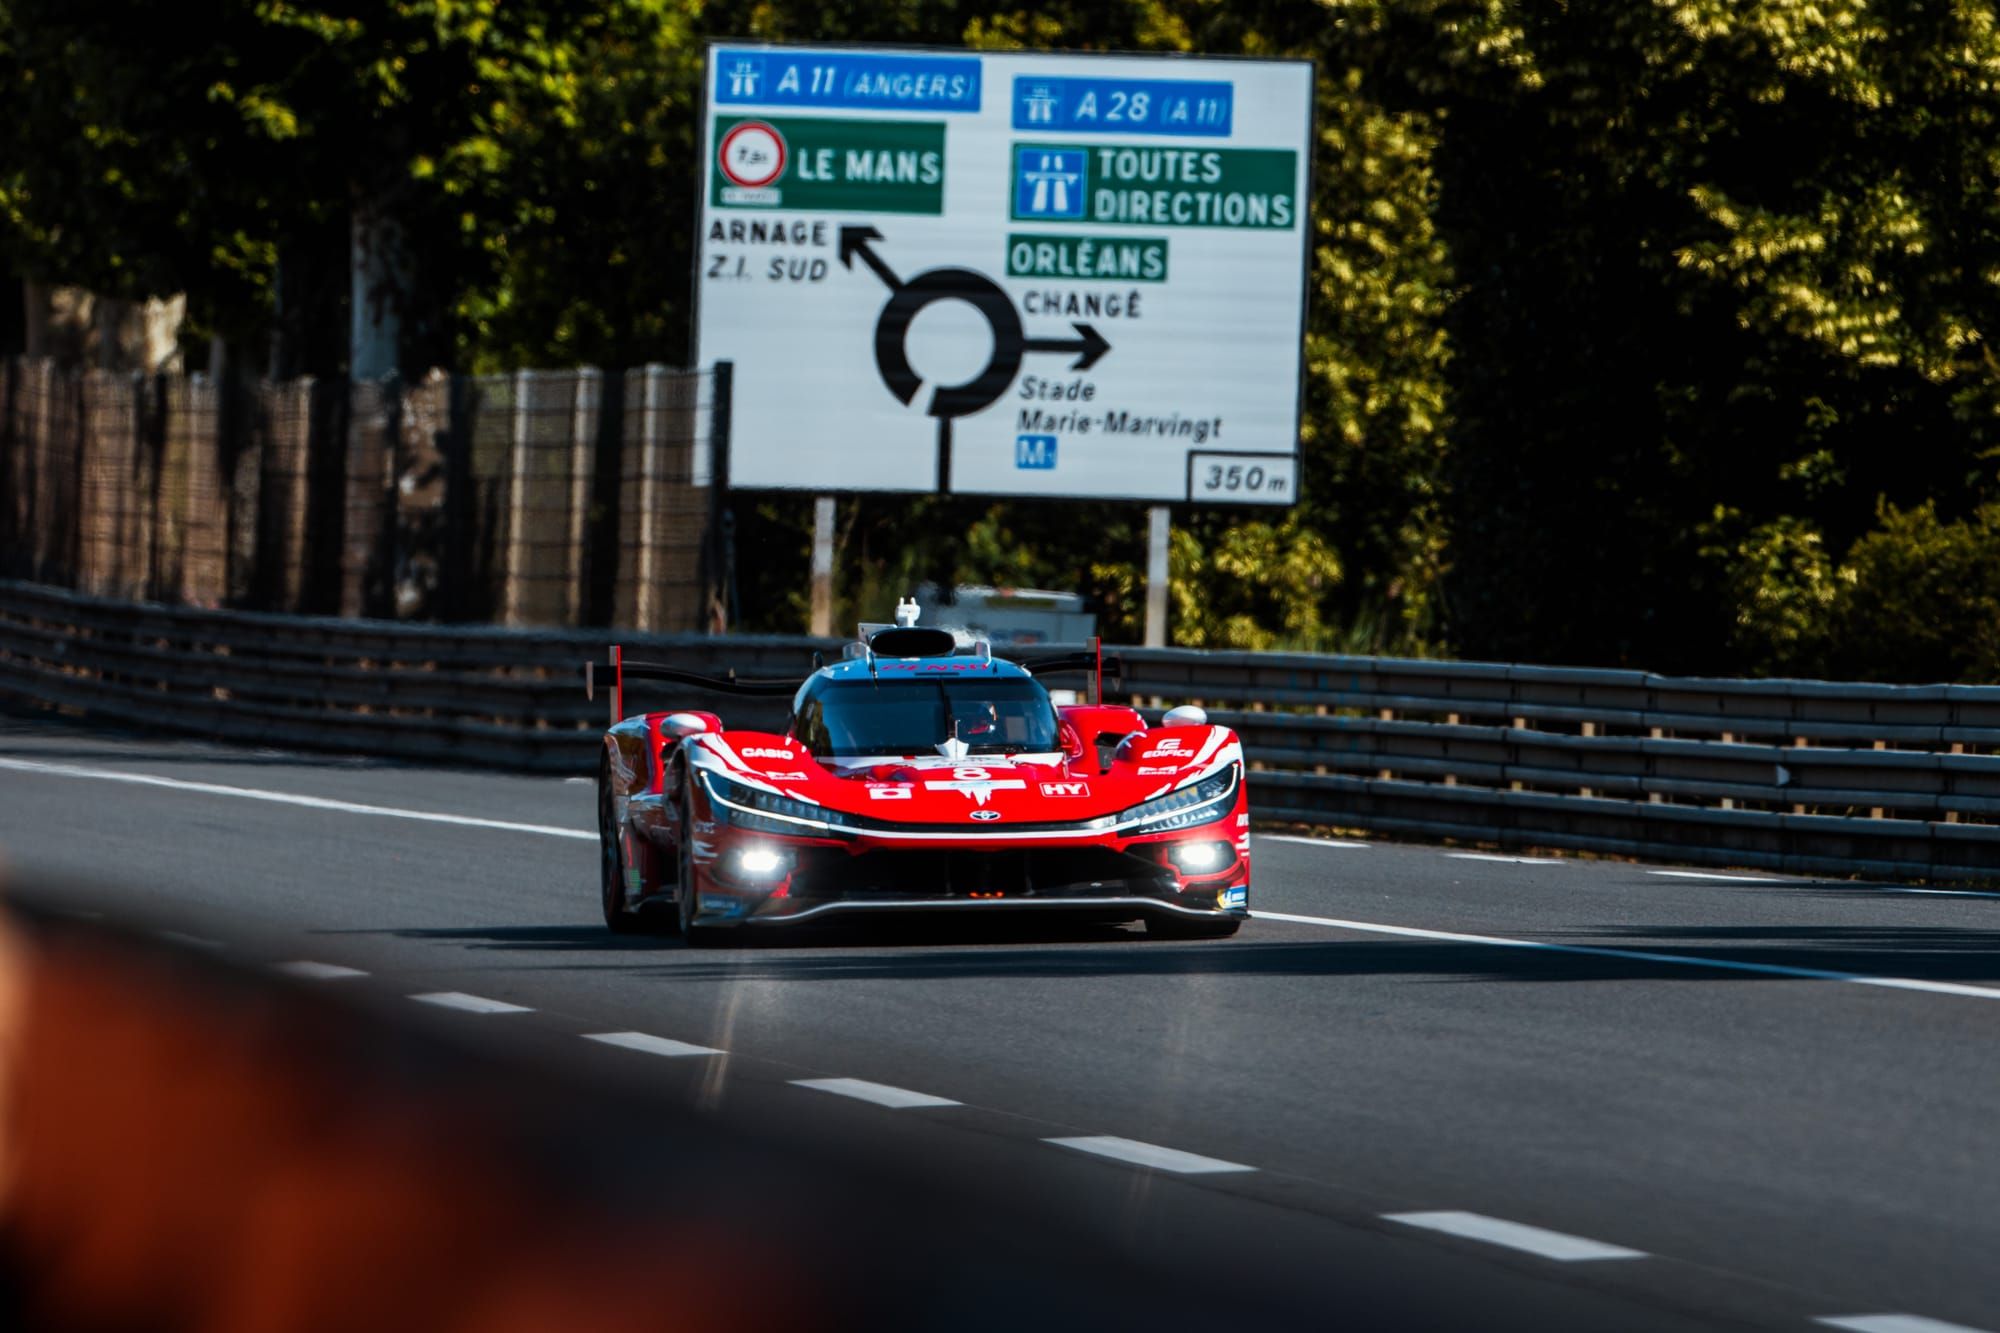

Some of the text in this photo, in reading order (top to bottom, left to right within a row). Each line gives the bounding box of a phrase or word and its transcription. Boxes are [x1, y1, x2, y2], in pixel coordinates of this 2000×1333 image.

[777, 66, 976, 98] A 11 (ANGERS)
[1075, 90, 1098, 120] A
[1105, 92, 1150, 122] 28
[797, 149, 941, 184] LE MANS
[1097, 149, 1222, 184] TOUTES
[1094, 188, 1291, 226] DIRECTIONS
[708, 219, 829, 247] ARNAGE
[767, 257, 829, 283] SUD
[1010, 238, 1164, 279] ORLÉANS
[1023, 290, 1142, 318] CHANGÉ
[1018, 375, 1097, 402] Stade
[1017, 409, 1223, 443] Marie-Marvingt
[741, 747, 795, 761] CASIO
[952, 766, 992, 781] 8
[1043, 781, 1087, 796] HY
